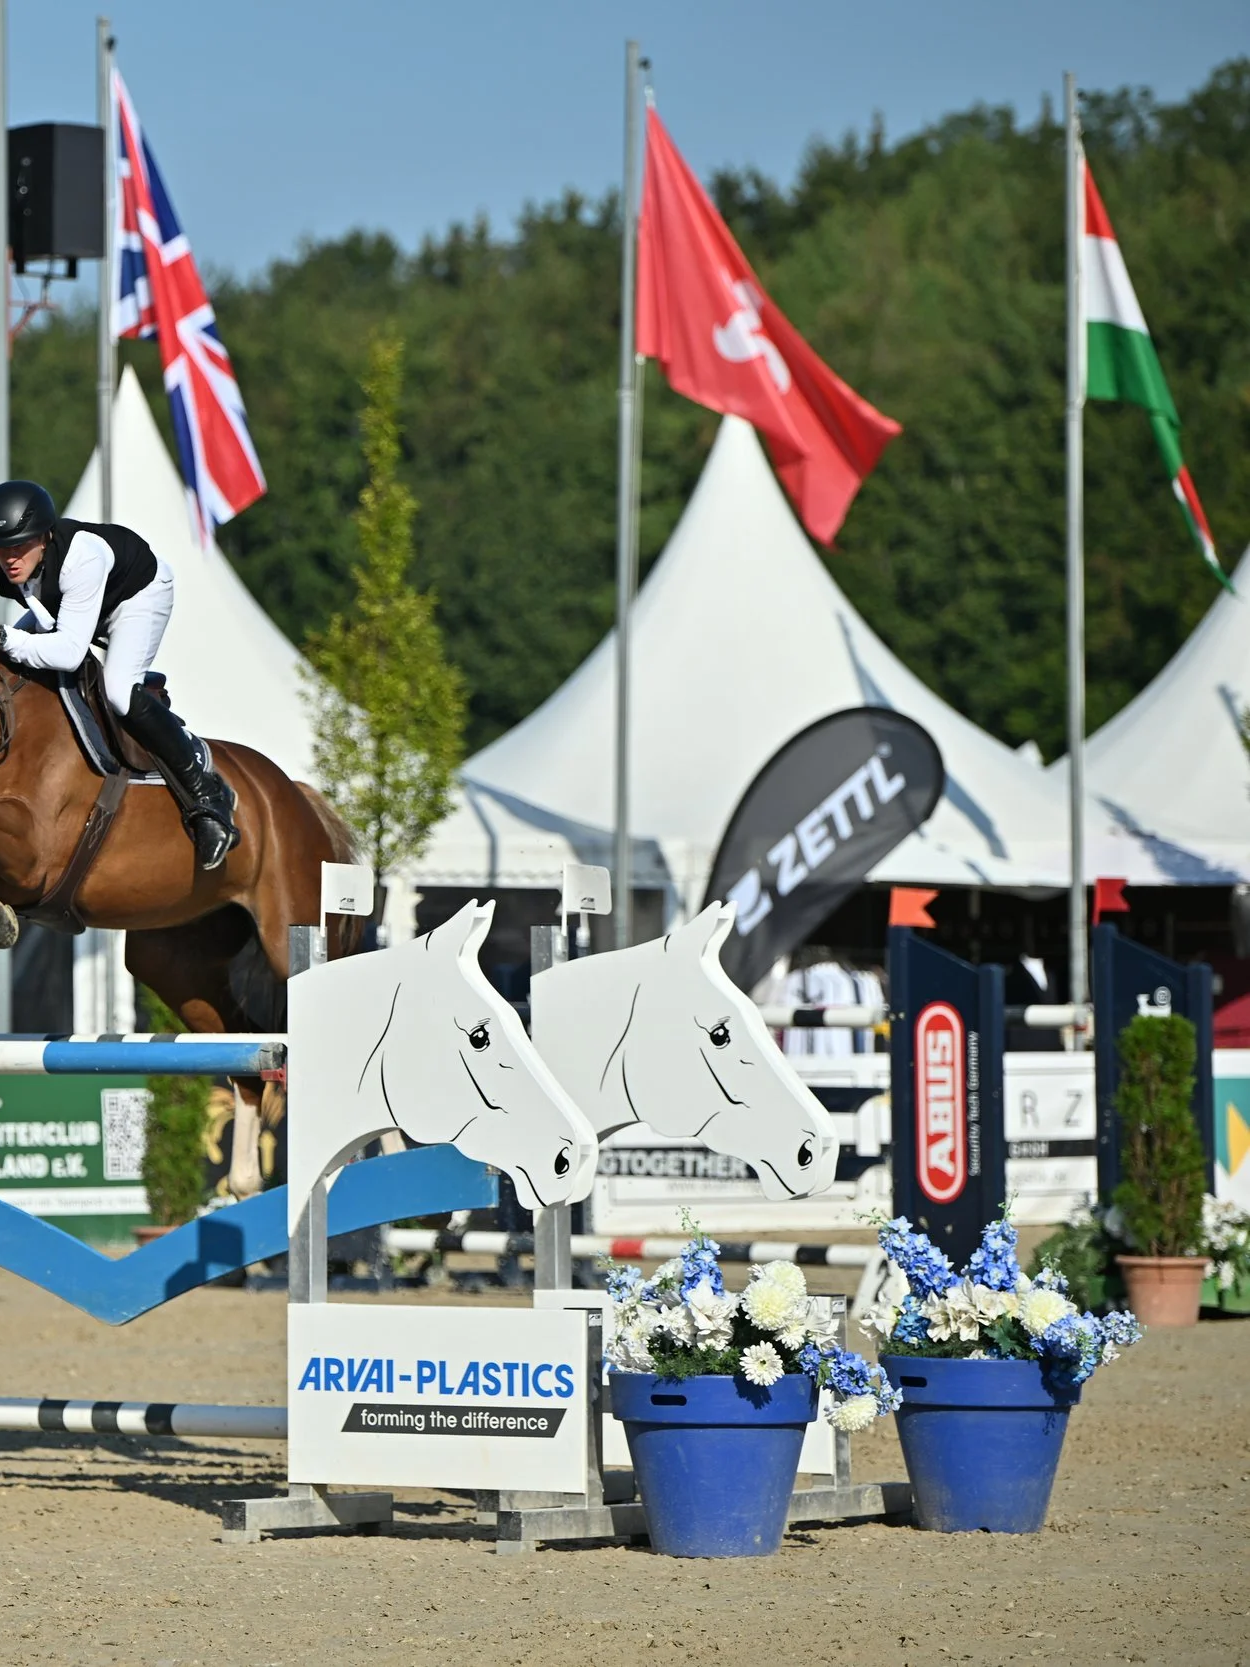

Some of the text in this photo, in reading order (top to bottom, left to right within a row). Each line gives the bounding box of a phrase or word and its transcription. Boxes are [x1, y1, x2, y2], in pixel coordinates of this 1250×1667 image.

[766, 754, 906, 896] ZETTL
[926, 1030, 955, 1177] ABUS
[298, 1357, 574, 1398] ARVAI-PLASTICS
[361, 1409, 548, 1431] forming the difference
